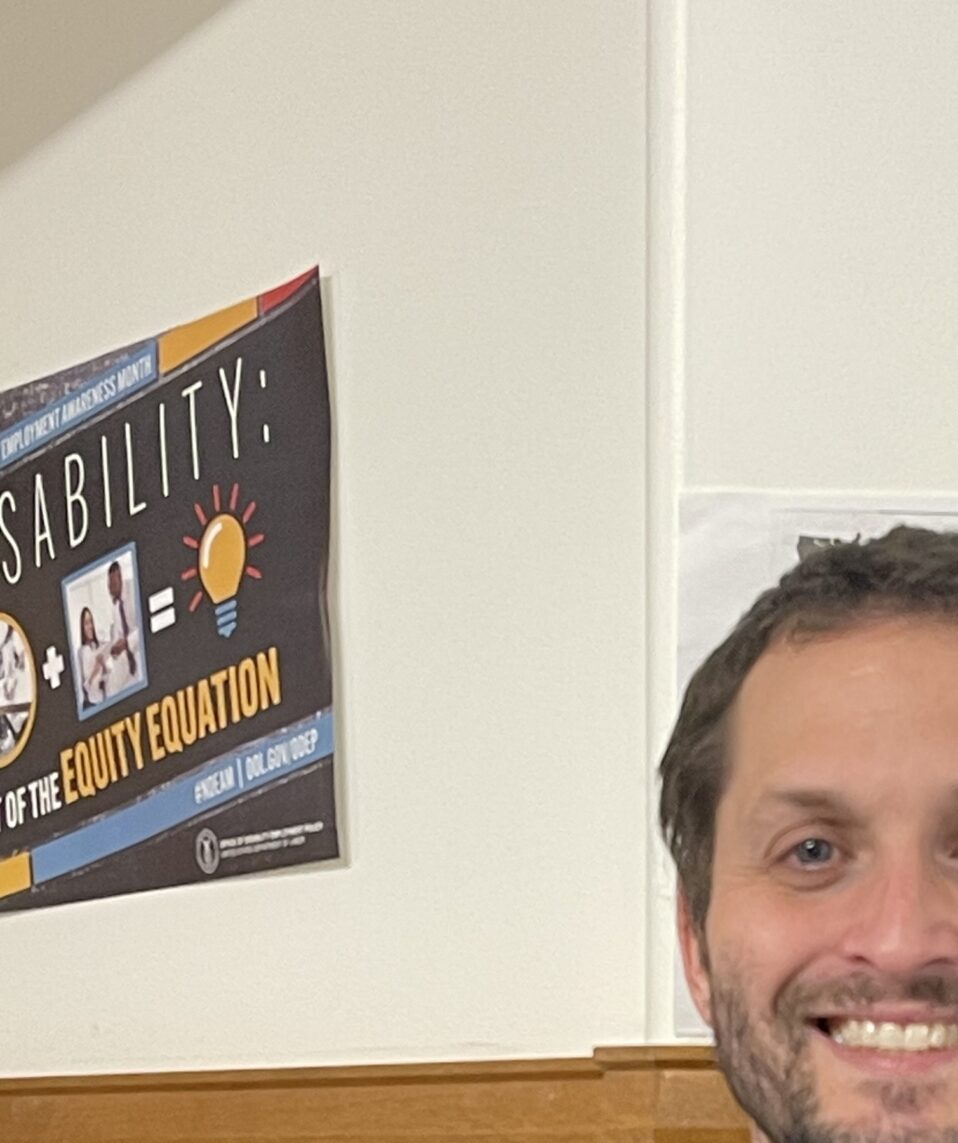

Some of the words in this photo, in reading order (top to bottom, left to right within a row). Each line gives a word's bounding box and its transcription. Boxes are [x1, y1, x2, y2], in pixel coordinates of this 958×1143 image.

[61, 375, 117, 425] AWARENESS
[116, 354, 152, 392] MONTH
[5, 791, 26, 828] OF
[28, 772, 62, 818] THE
[60, 712, 144, 804] EQUITY
[146, 647, 281, 761] EQUATION
